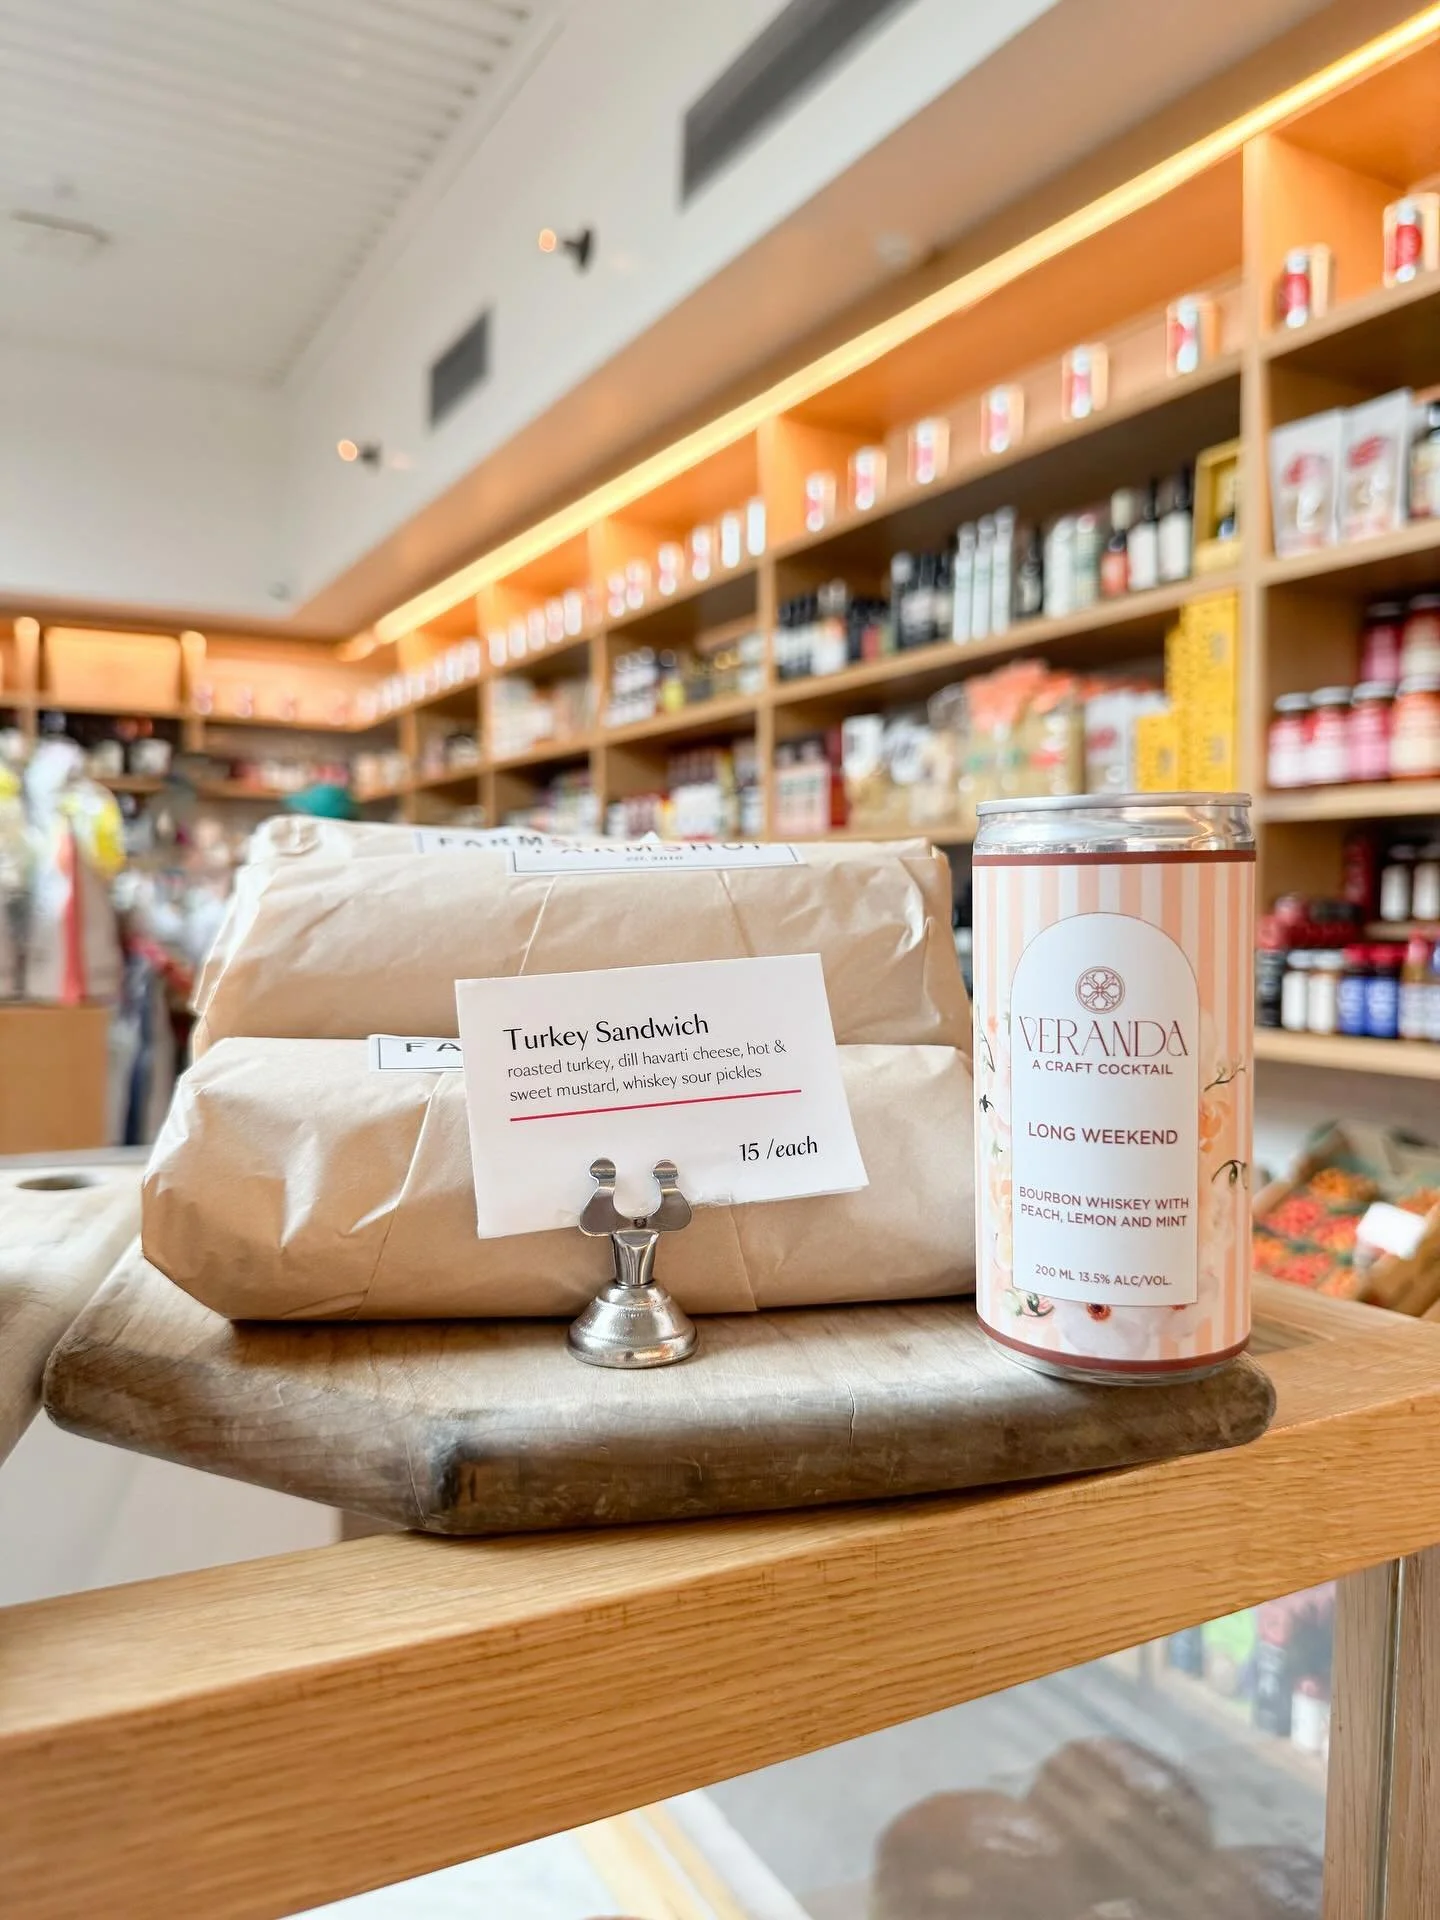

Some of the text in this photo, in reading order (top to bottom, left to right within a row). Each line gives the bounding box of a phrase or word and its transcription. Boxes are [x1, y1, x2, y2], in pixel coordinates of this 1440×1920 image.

[502, 1012, 709, 1052] Turkey Sandwich
[1018, 1015, 1189, 1058] VERANDA
[405, 1040, 462, 1053] FA
[507, 1039, 788, 1079] roasted turkey, dill havarti cheese, hot &
[1031, 1059, 1174, 1076] A CRAFT COCKTAIL
[509, 1064, 763, 1102] sweet mustard, whiskey sour pickles
[1028, 1121, 1179, 1146] LONG WEEKEND
[738, 1135, 818, 1162] 15 /each
[1019, 1185, 1190, 1211] BOURBON WHISKEY WITH
[1020, 1203, 1188, 1228] PEACH, LEMON AND MINT
[1035, 1263, 1173, 1288] 200 ML 13.5% ALC/VOL.
